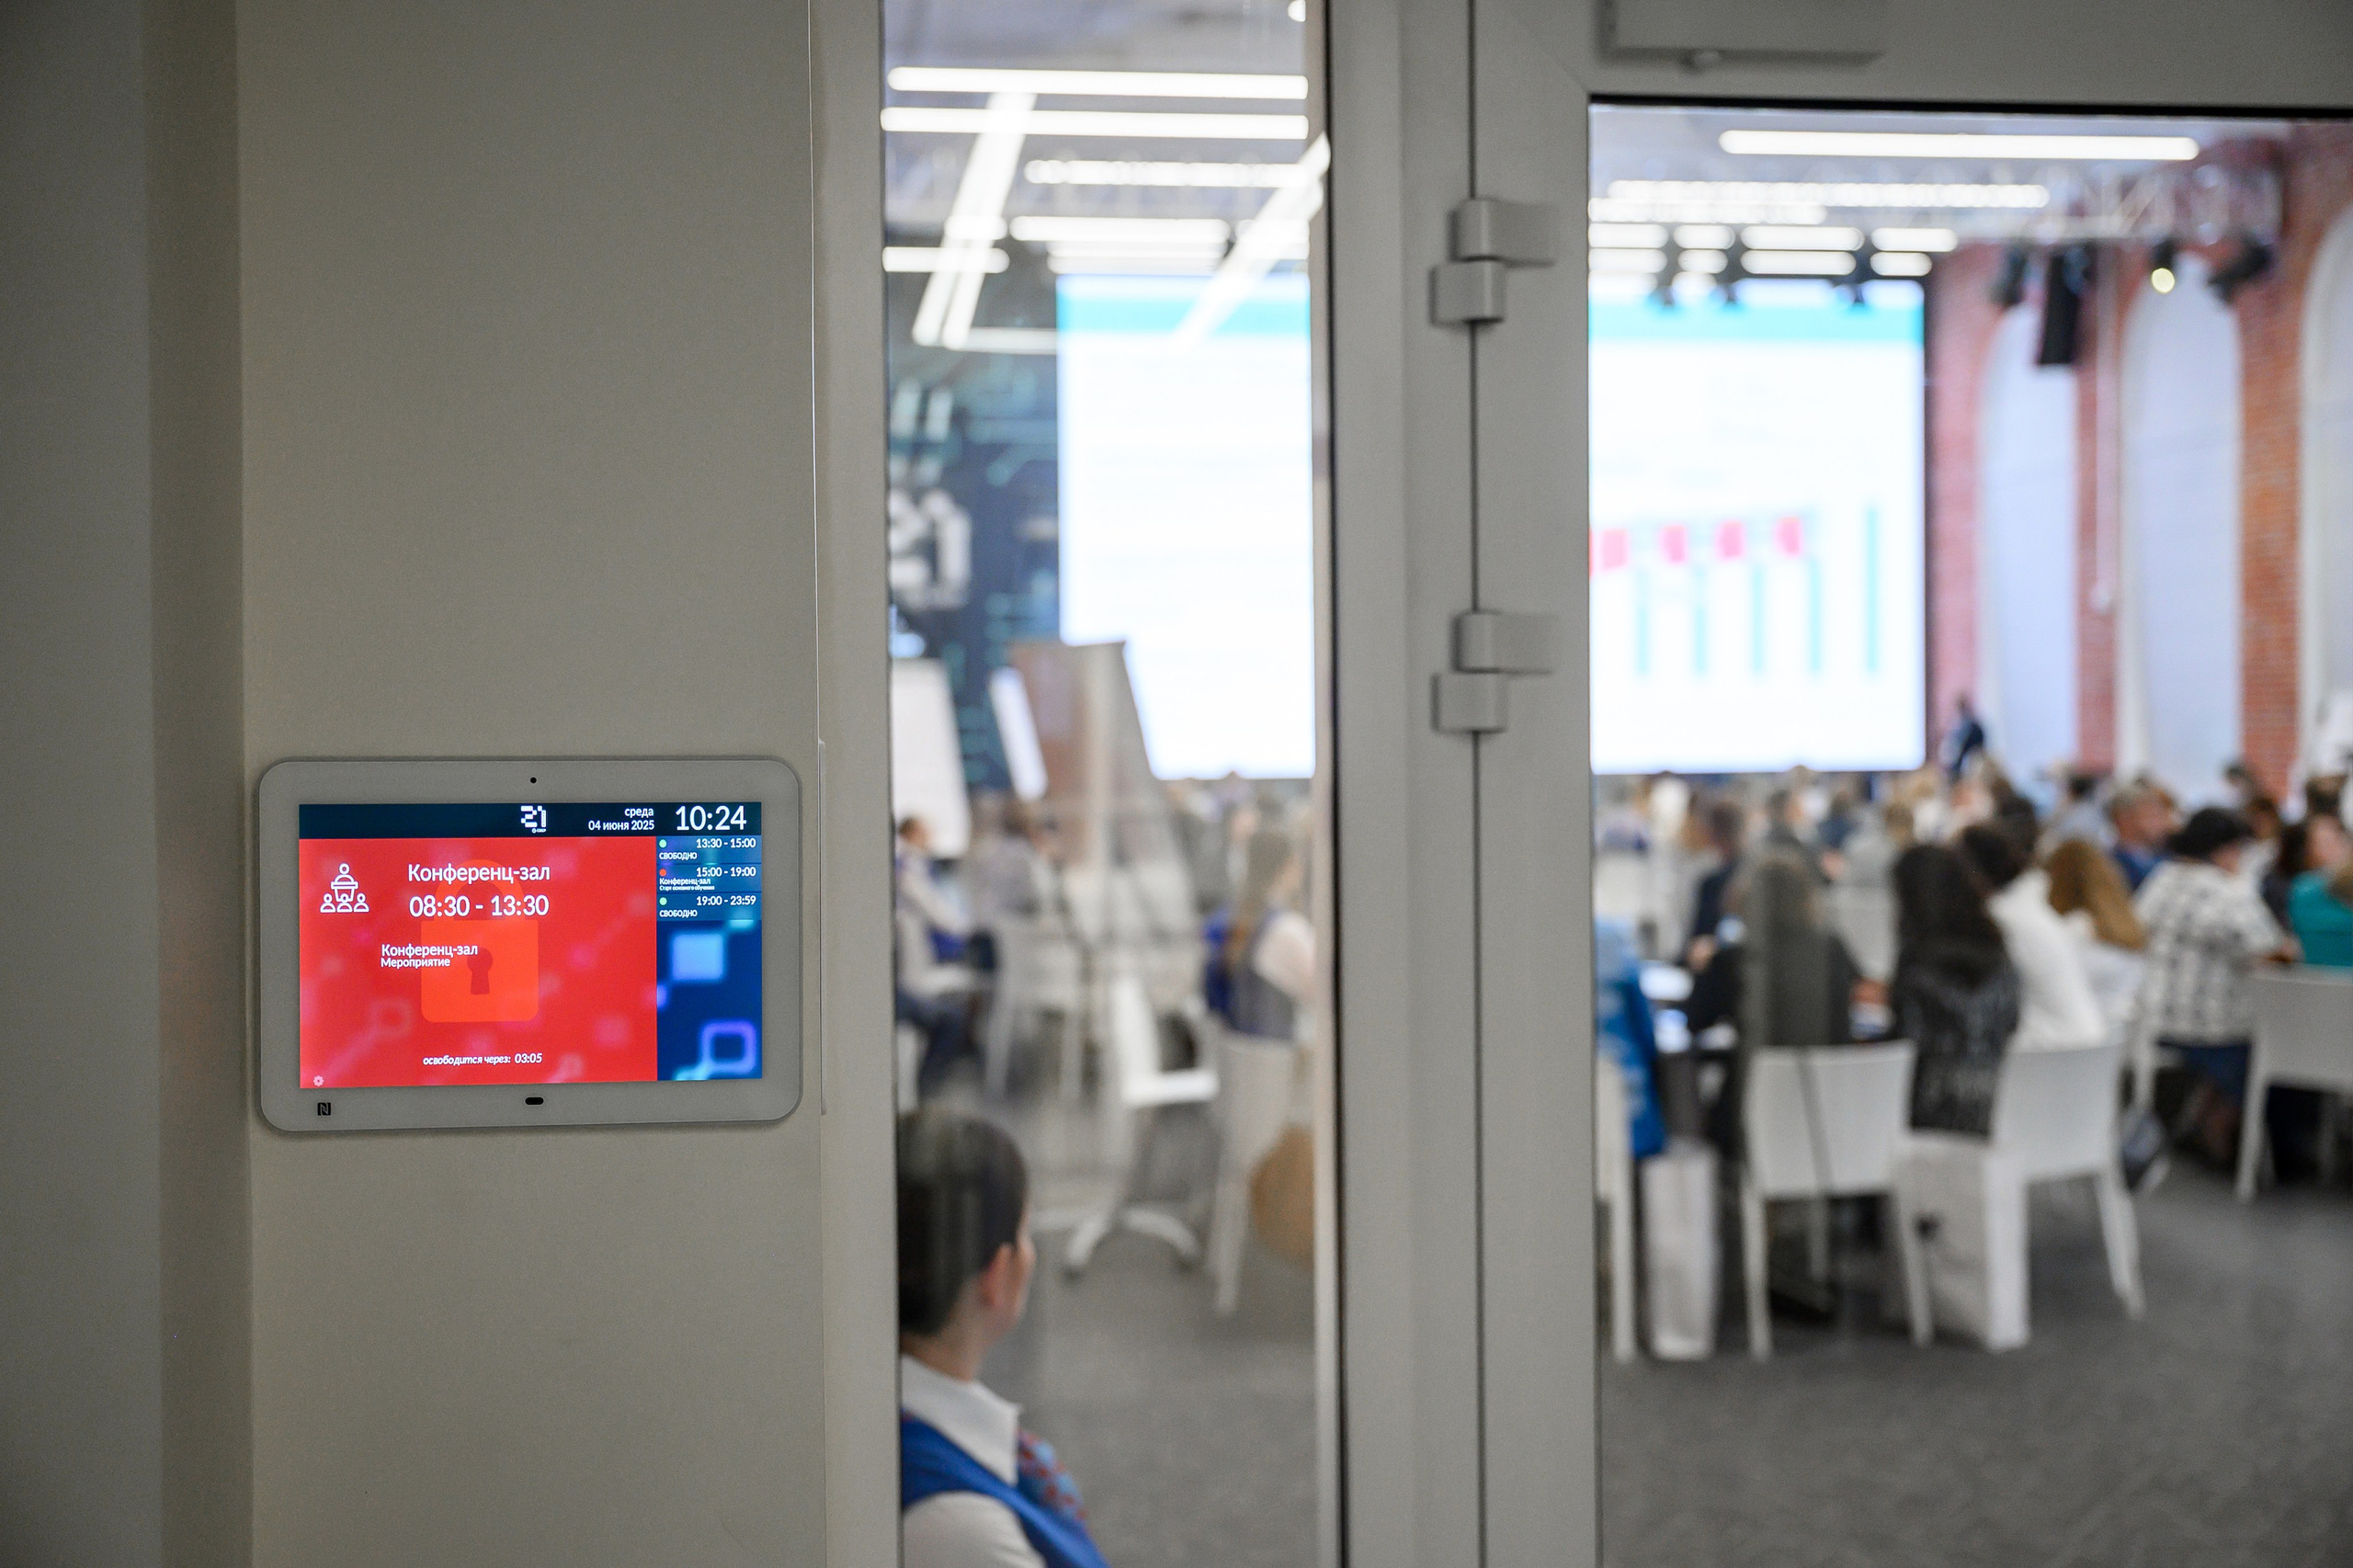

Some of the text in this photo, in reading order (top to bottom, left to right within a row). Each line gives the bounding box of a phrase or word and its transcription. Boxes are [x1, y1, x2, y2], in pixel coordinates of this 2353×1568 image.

[521, 806, 546, 827] 21
[624, 808, 654, 818] среда
[676, 805, 747, 831] 10:24
[588, 820, 654, 831] 04 июня 2025
[696, 838, 722, 848] 13:30
[730, 837, 756, 848] 15:00
[659, 852, 698, 861] СВОБОДНО
[408, 863, 551, 884] Конференц-зал
[696, 867, 722, 877] 15:00
[730, 867, 756, 877] 19:00
[409, 894, 471, 917] 08:30
[491, 894, 550, 916] 13:30
[696, 895, 722, 906] 19:00
[730, 895, 756, 905] 23:59
[659, 909, 698, 918] СВОБОДНО
[381, 943, 478, 958] Конференц-зал
[381, 958, 450, 969] Мероприятие
[423, 1052, 542, 1066] освободится через: 03:05
